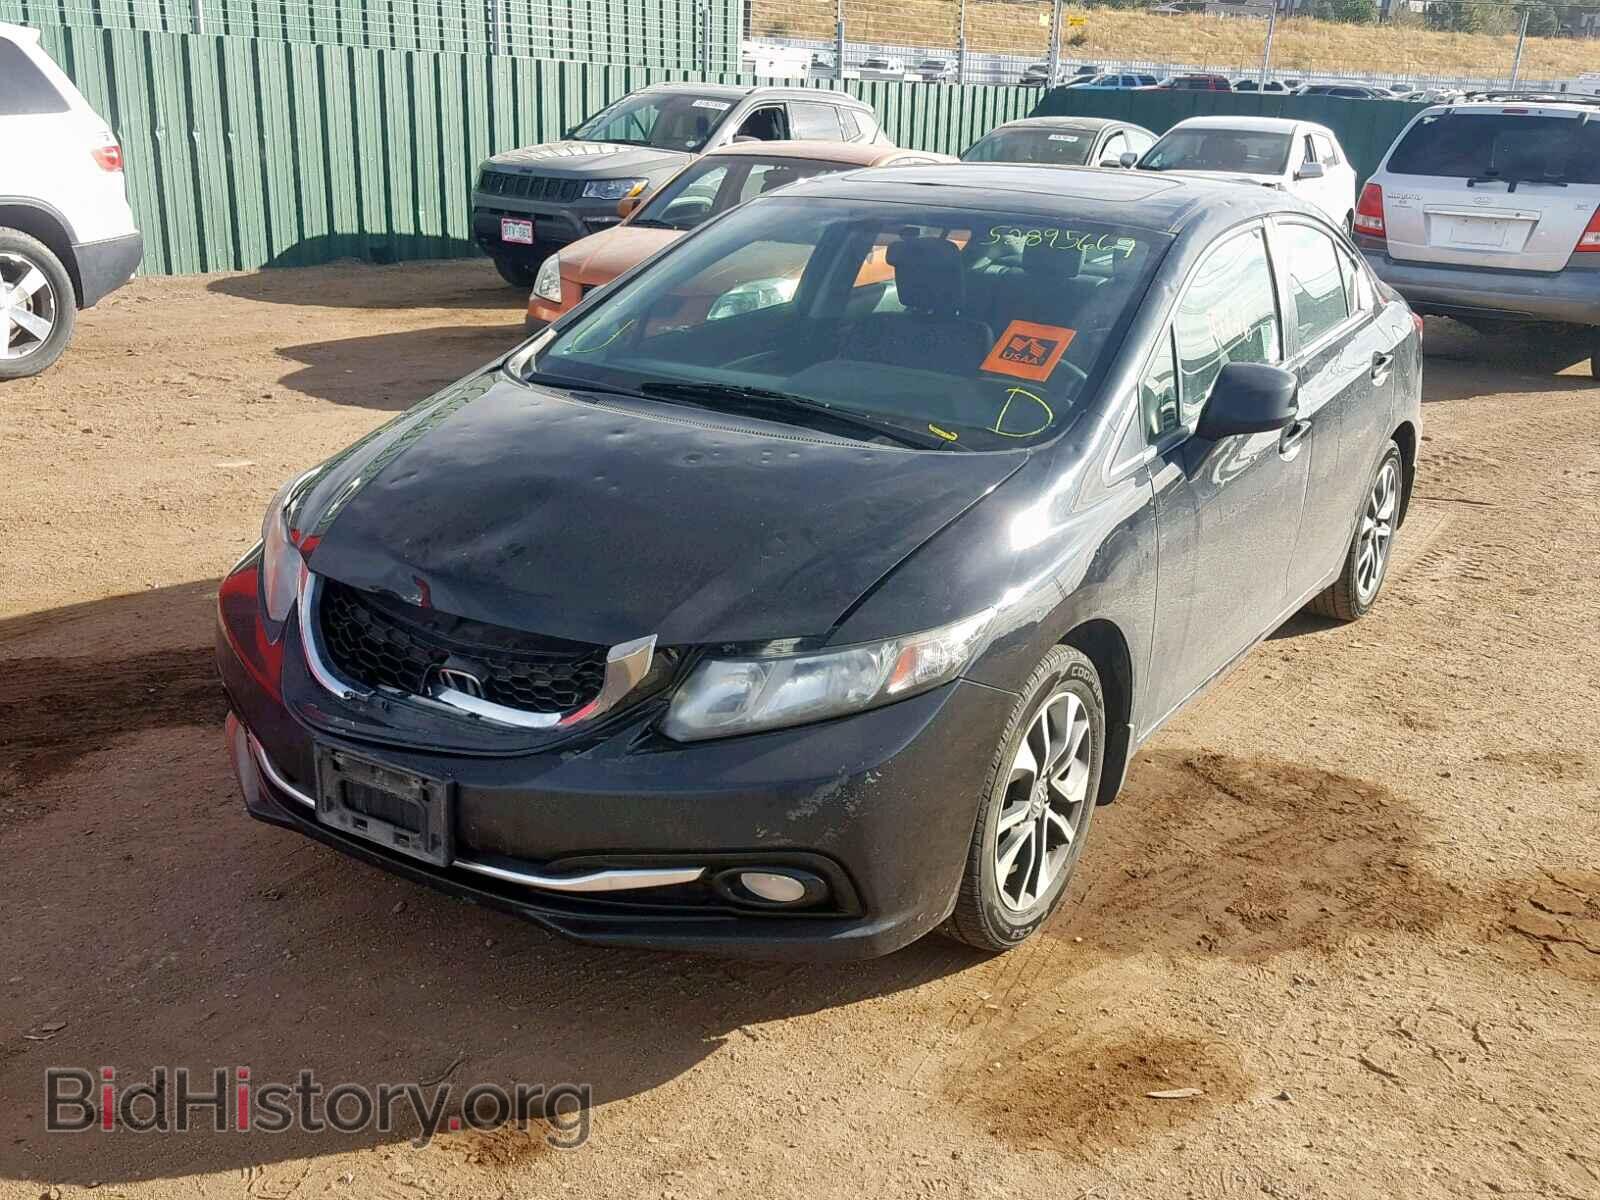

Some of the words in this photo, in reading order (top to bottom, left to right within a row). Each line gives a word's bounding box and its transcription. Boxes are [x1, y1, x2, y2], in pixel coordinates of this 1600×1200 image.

[1003, 350, 1040, 365] USAA
[987, 387, 1054, 438] D
[1071, 665, 1103, 702] COOPER
